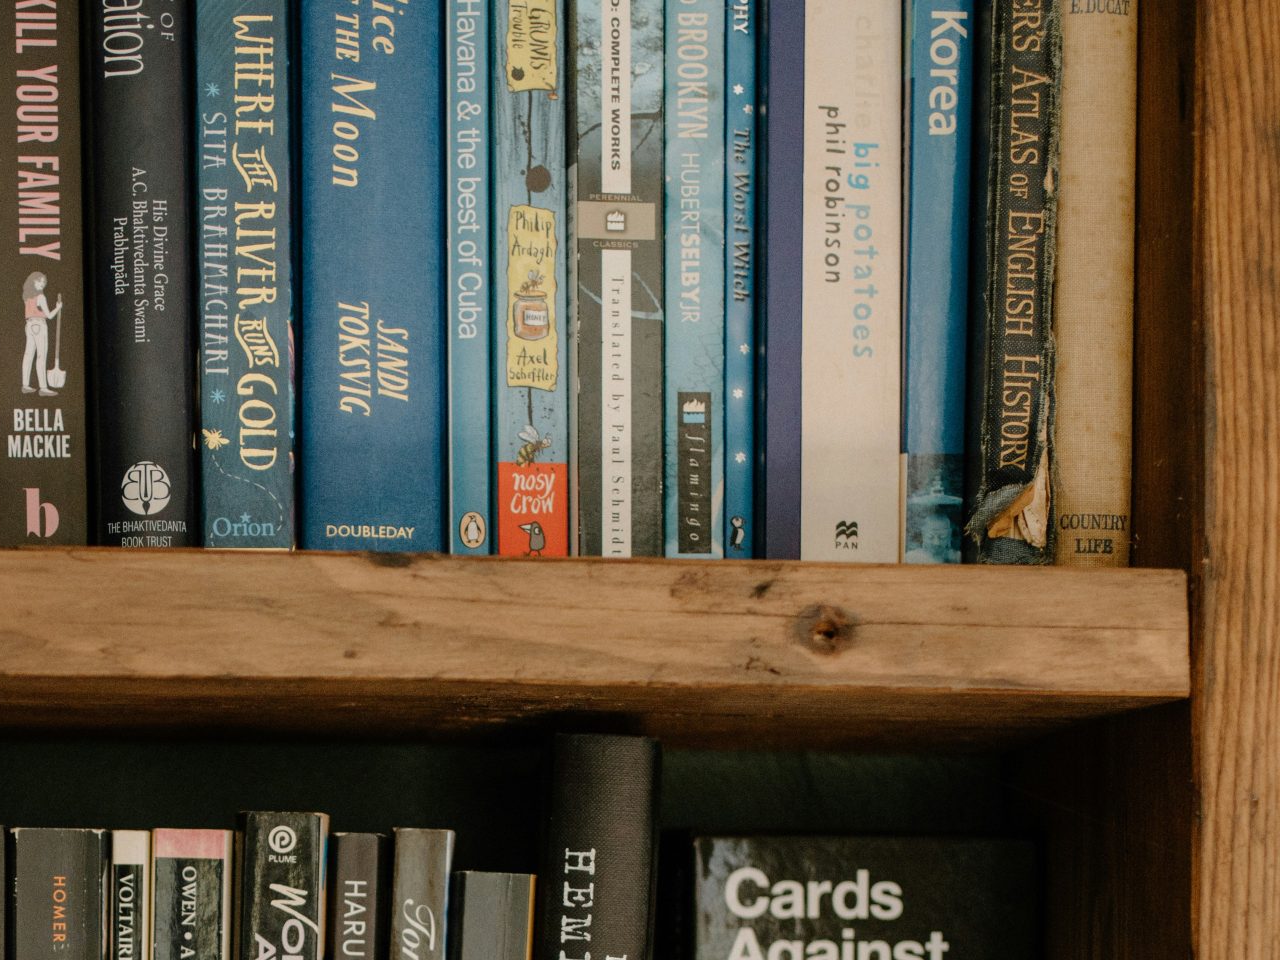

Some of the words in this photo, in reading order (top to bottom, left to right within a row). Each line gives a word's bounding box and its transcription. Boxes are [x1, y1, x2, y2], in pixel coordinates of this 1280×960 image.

[232, 15, 274, 136] WHERE
[456, 0, 481, 93] Havana
[611, 17, 621, 103] COMPLETE
[677, 13, 709, 138] BROOKLYN
[928, 10, 967, 136] Korea
[16, 65, 59, 143] YOUR
[331, 73, 377, 188] Moon
[1010, 65, 1051, 165] ATLAS
[203, 112, 227, 170] SITA
[457, 127, 481, 169] the
[848, 142, 880, 190] big
[17, 155, 61, 261] FAMILY
[152, 199, 167, 222] His
[457, 177, 481, 234] best
[514, 211, 552, 238] Philip
[589, 193, 643, 202] PERENNIAL
[733, 172, 752, 233] Worst
[824, 165, 845, 283] robinson
[132, 200, 148, 298] Bhaktivedanta
[153, 225, 168, 271] Divine
[234, 200, 276, 309] RIVER
[511, 235, 553, 265] Ardagh
[592, 240, 639, 248] CLASSICS
[733, 241, 751, 303] Witch
[1005, 210, 1044, 337] ENGLISH
[203, 188, 229, 376] BRAHMACHARI
[458, 272, 482, 339] Cuba
[846, 203, 880, 359] potatoes
[337, 301, 371, 416] TOKSVIG
[516, 346, 548, 366] Axel
[611, 276, 624, 382] Translated
[376, 319, 409, 402] SANDI
[509, 368, 555, 383] Scheffler
[13, 408, 64, 432] BELLA
[236, 373, 278, 470] GOLD
[1000, 354, 1039, 471] HISTORY
[7, 434, 71, 458] MACKIE
[611, 424, 624, 463] Paul
[512, 472, 556, 499] nosy
[611, 476, 624, 554] Schmidt
[122, 520, 187, 533] BHAKTIVEDANTA
[146, 535, 172, 547] TRUST
[213, 514, 275, 537] Orion
[325, 524, 415, 540] DOUBLEDAY
[835, 541, 858, 550] PAN
[1059, 514, 1126, 531] COUNTRY
[181, 865, 197, 926] OWEN
[724, 866, 904, 920] Cards
